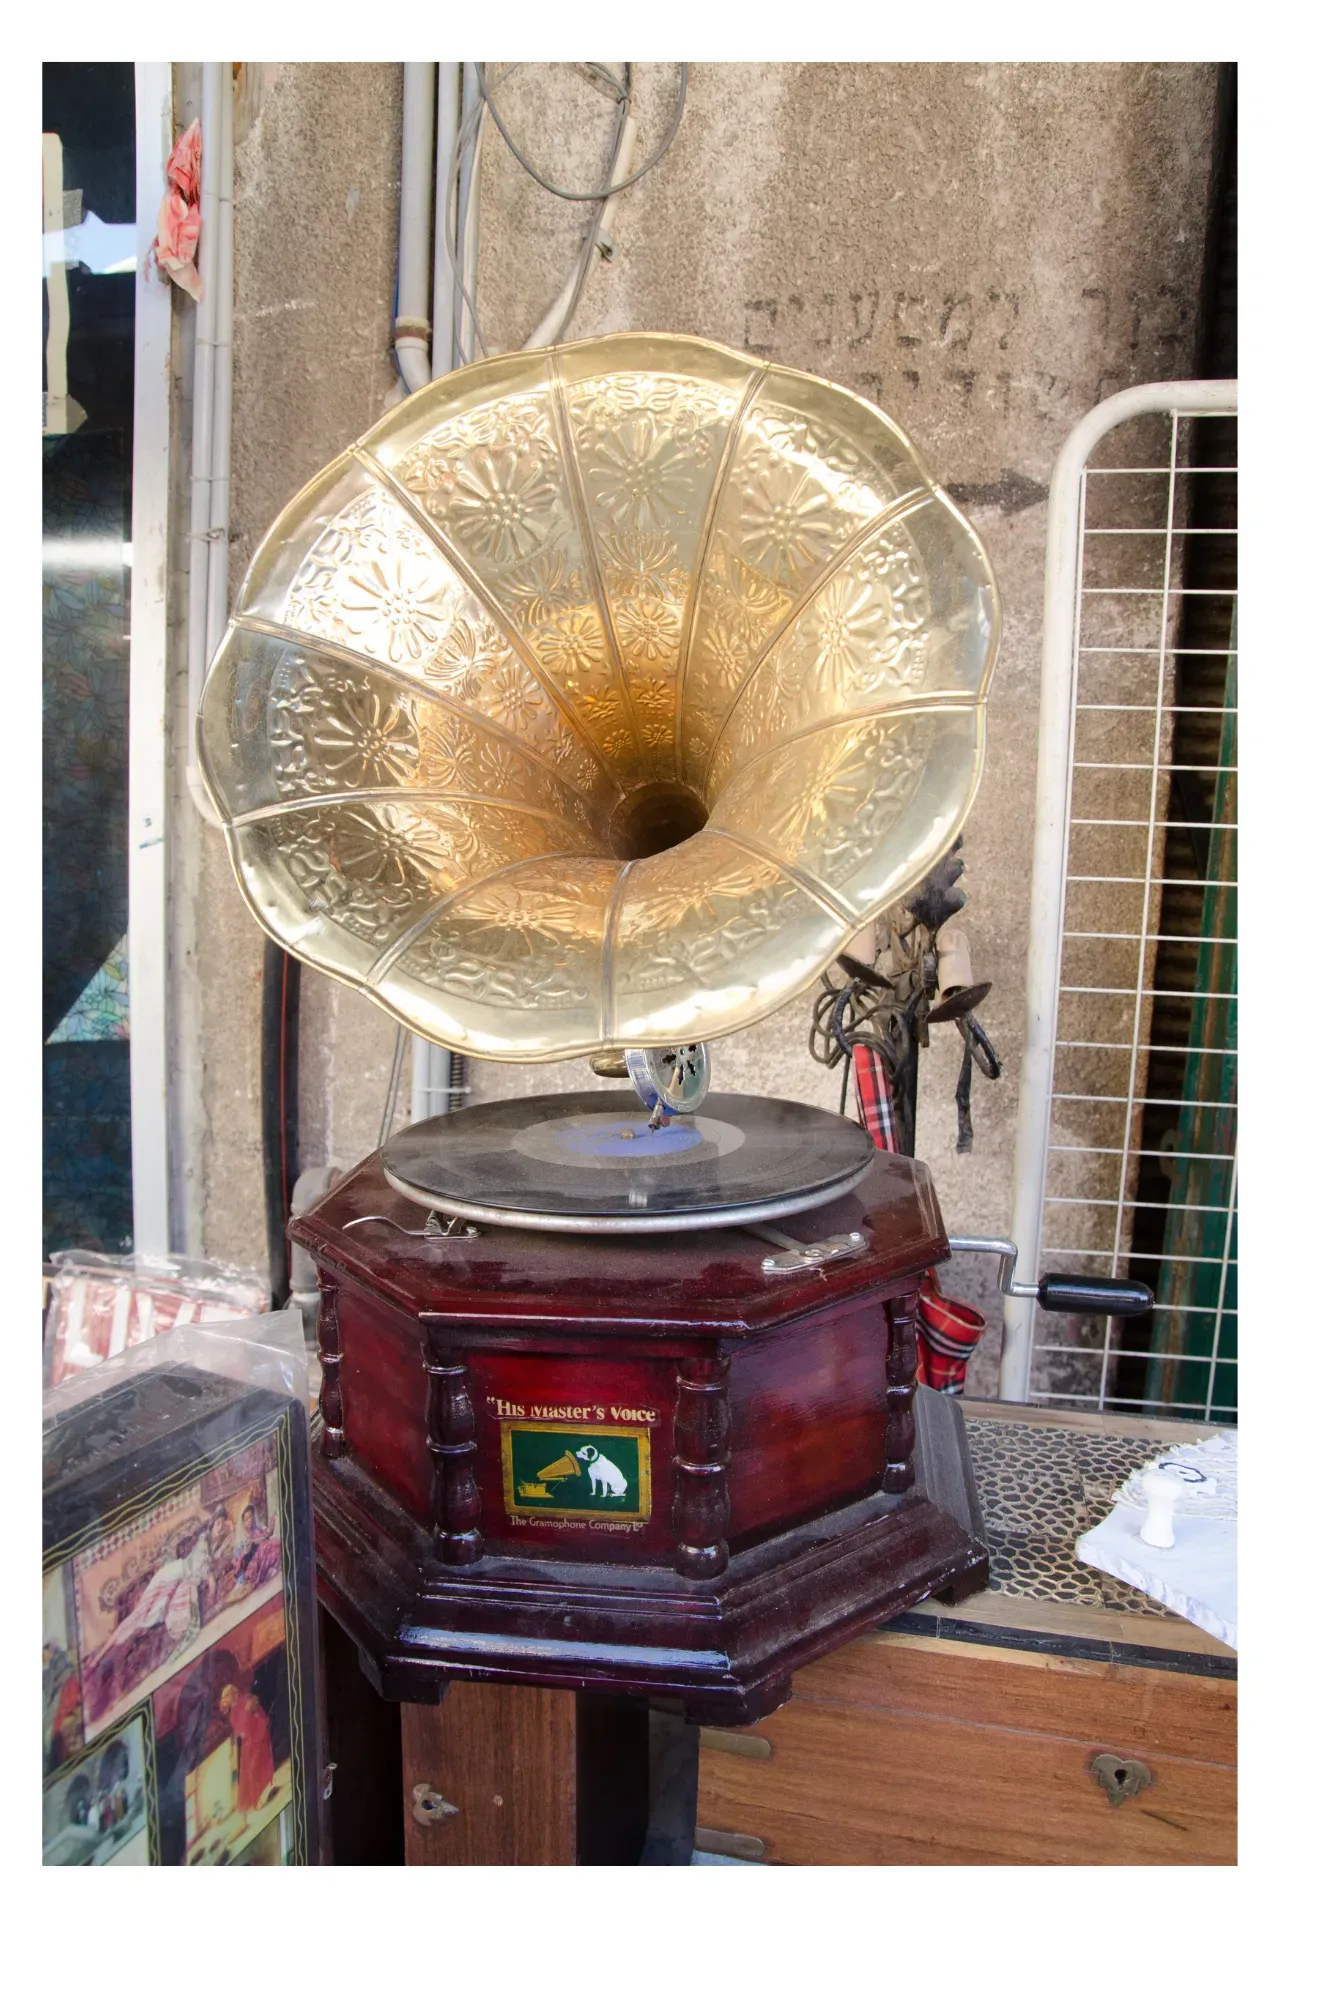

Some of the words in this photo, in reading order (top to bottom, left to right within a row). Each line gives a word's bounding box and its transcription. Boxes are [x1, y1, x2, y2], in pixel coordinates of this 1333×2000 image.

[530, 1404, 605, 1420] Master's
[610, 1406, 656, 1422] Voice
[509, 1515, 527, 1526] The
[529, 1516, 587, 1530] Gramophone
[588, 1520, 632, 1534] Company
